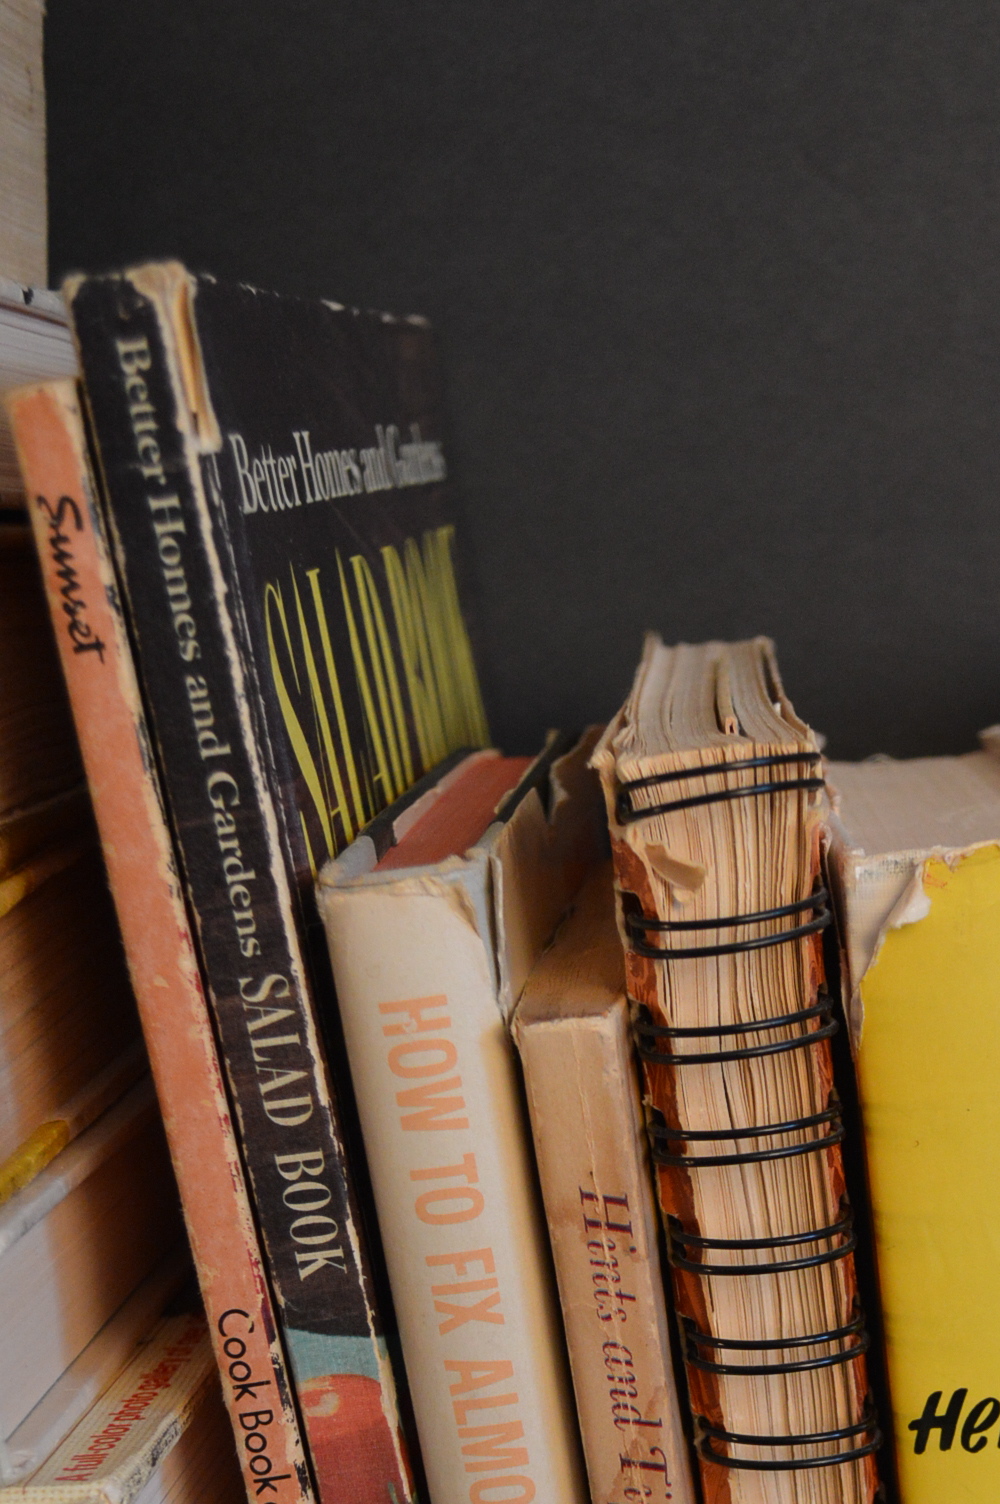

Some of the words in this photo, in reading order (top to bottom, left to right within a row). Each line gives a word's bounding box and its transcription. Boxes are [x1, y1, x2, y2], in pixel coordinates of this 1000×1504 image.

[116, 335, 167, 485] Better
[229, 432, 303, 515] Better
[293, 431, 362, 504] Homes
[37, 494, 106, 665] Sunset
[148, 493, 202, 662] Homes
[185, 674, 232, 762] and
[206, 769, 261, 958] Gardens
[238, 973, 315, 1127] SALAD
[378, 993, 470, 1132] HOW
[273, 1147, 347, 1281] BOOK
[409, 1152, 486, 1226] TO
[425, 1247, 505, 1335] FIX
[579, 1185, 637, 1324] Hints
[217, 1308, 271, 1402] Cook
[602, 1340, 663, 1432] and
[63, 1423, 132, 1471] full-color
[237, 1408, 292, 1494] Book
